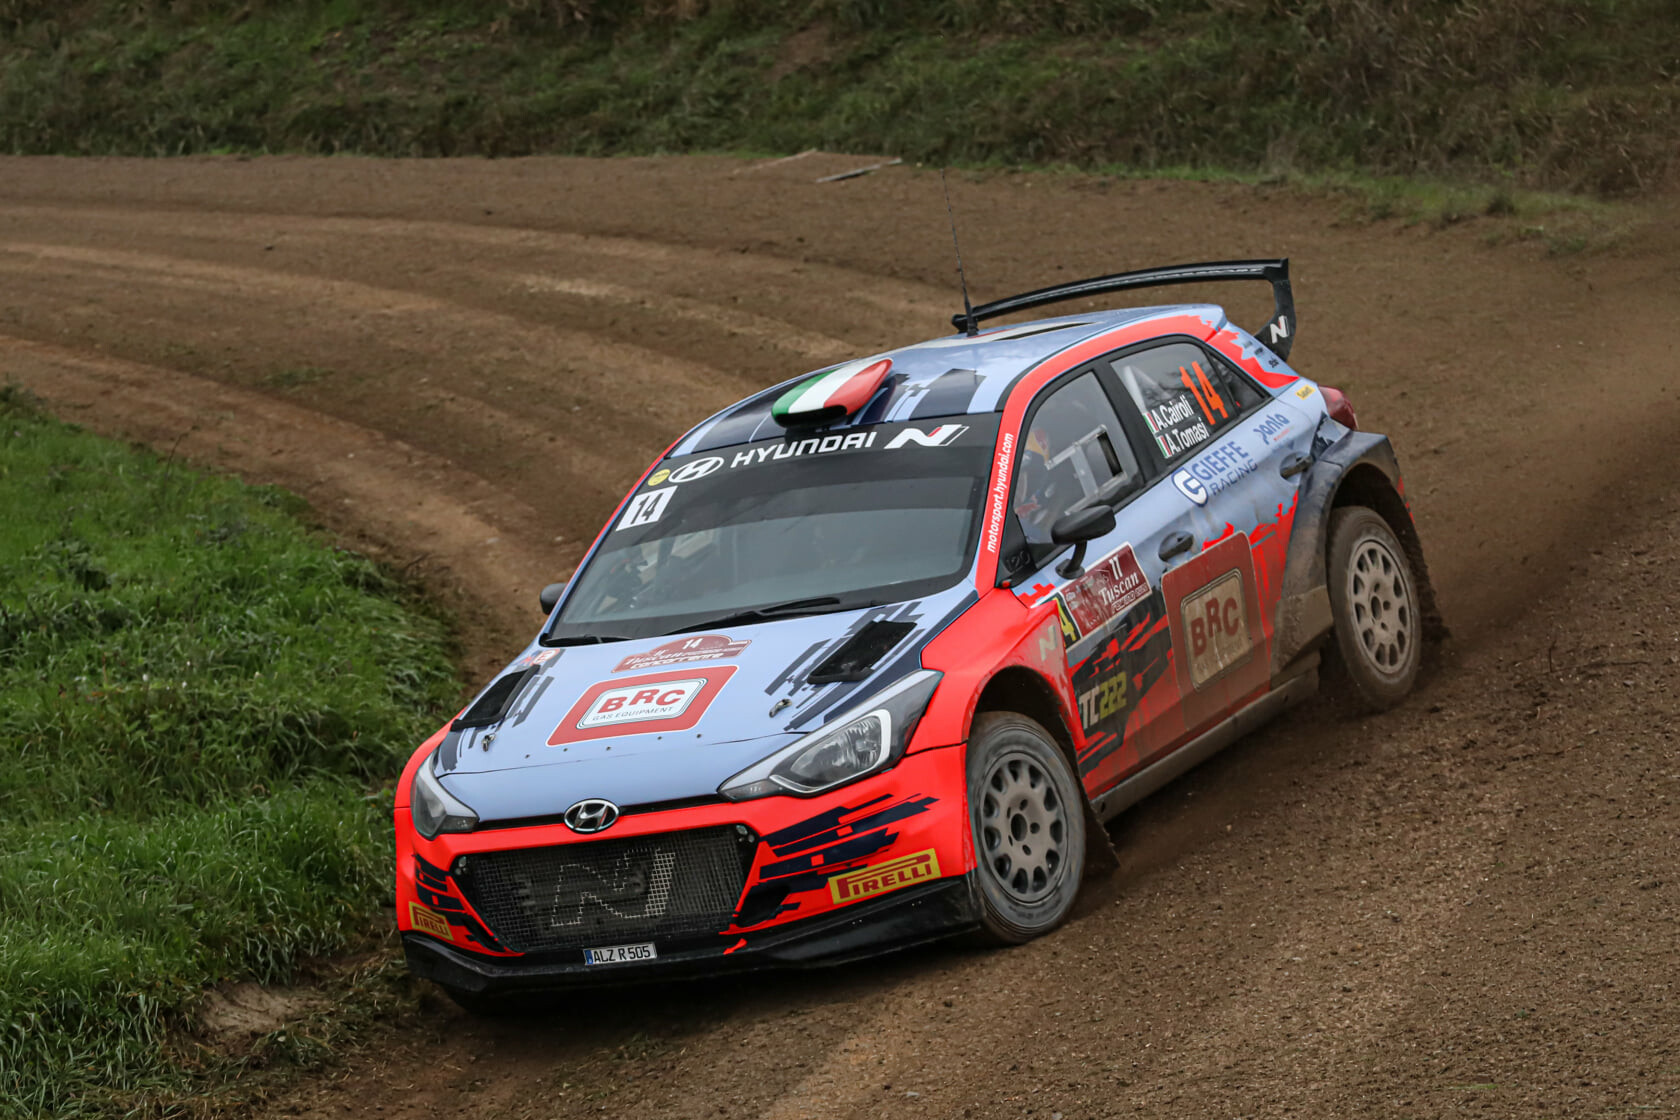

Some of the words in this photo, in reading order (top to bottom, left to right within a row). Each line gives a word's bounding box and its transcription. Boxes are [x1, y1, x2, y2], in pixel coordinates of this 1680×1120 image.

[1179, 361, 1229, 425] 14
[1151, 394, 1194, 431] A.Cairoli
[730, 431, 878, 468] HYUNDAI
[1164, 416, 1210, 456] A.Tomasi
[1191, 441, 1249, 480] GIEFFE
[1209, 458, 1258, 496] RACING
[629, 493, 661, 525] 14
[987, 433, 1015, 553] motorsport.hyundai.com
[1098, 571, 1140, 606] Tuscan
[681, 637, 704, 650] 14
[1190, 596, 1240, 657] BRC
[592, 712, 614, 721] GAS
[615, 706, 674, 719] EQUIPMENT
[597, 688, 686, 714] BRC
[836, 853, 931, 899] PIRELLI
[412, 905, 450, 938] PIRELLI
[593, 949, 616, 962] ALZ
[618, 948, 627, 961] R
[627, 945, 651, 960] 505
